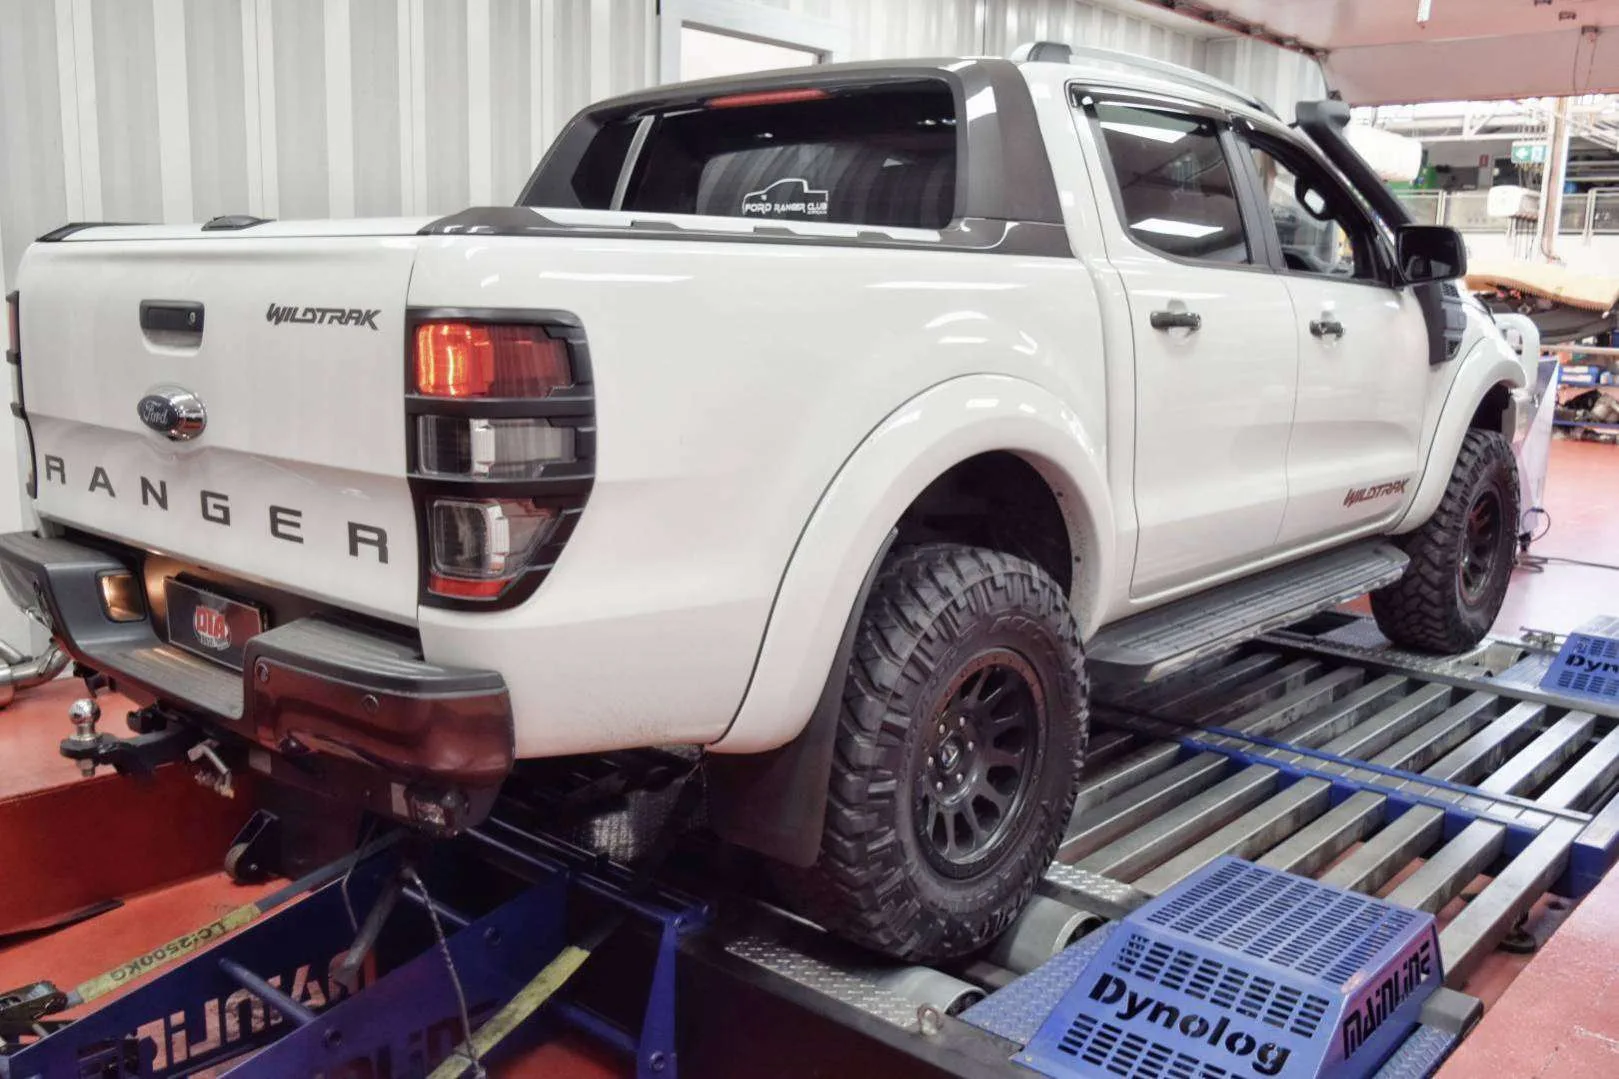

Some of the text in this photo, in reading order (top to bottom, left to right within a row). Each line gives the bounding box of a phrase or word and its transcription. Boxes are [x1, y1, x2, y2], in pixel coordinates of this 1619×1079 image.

[745, 202, 828, 214] FORD RANGER CLUB
[266, 303, 382, 330] WILDTRAK
[143, 400, 168, 424] Ford
[1343, 478, 1410, 507] WILDTRAK
[44, 454, 390, 564] RANGER
[1088, 972, 1293, 1076] Dynolog
